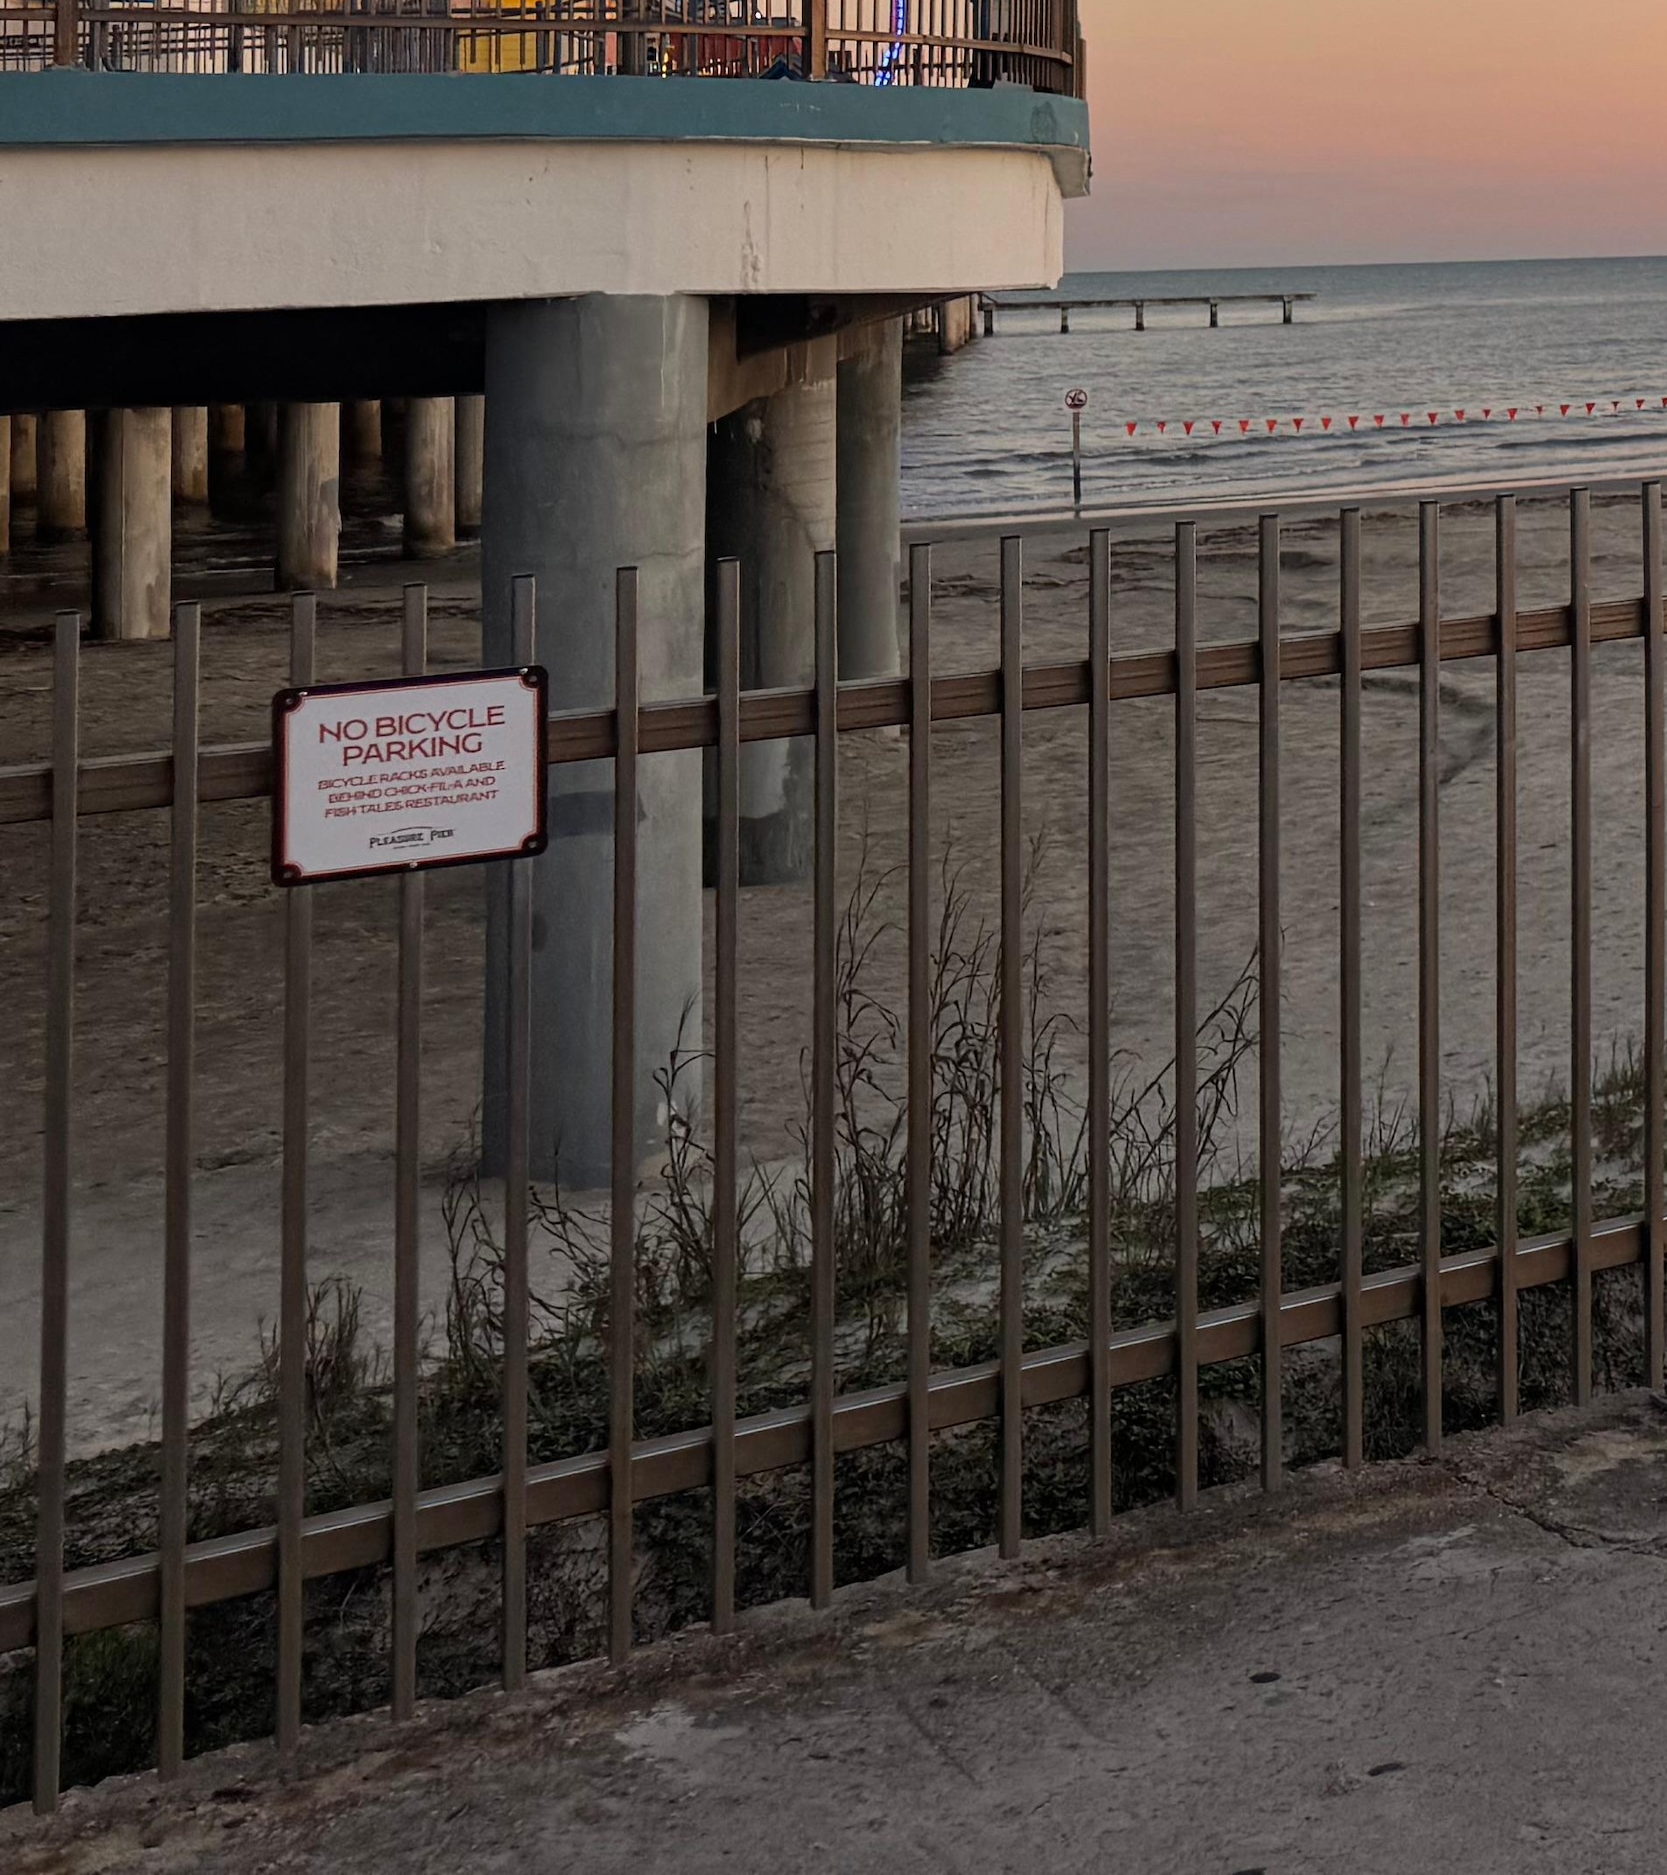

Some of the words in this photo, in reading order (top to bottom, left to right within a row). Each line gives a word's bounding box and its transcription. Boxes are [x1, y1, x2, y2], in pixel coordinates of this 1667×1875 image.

[319, 718, 368, 744] NO
[376, 705, 506, 737] BICYCLE
[343, 733, 482, 766] PARKING
[318, 775, 378, 790] BICYCLE
[379, 769, 428, 783] RACKS
[431, 760, 507, 777] AVAILABLE
[465, 776, 496, 788] AND
[324, 804, 357, 818] FISH
[359, 799, 404, 814] TALES
[405, 789, 499, 809] RESTAURANT
